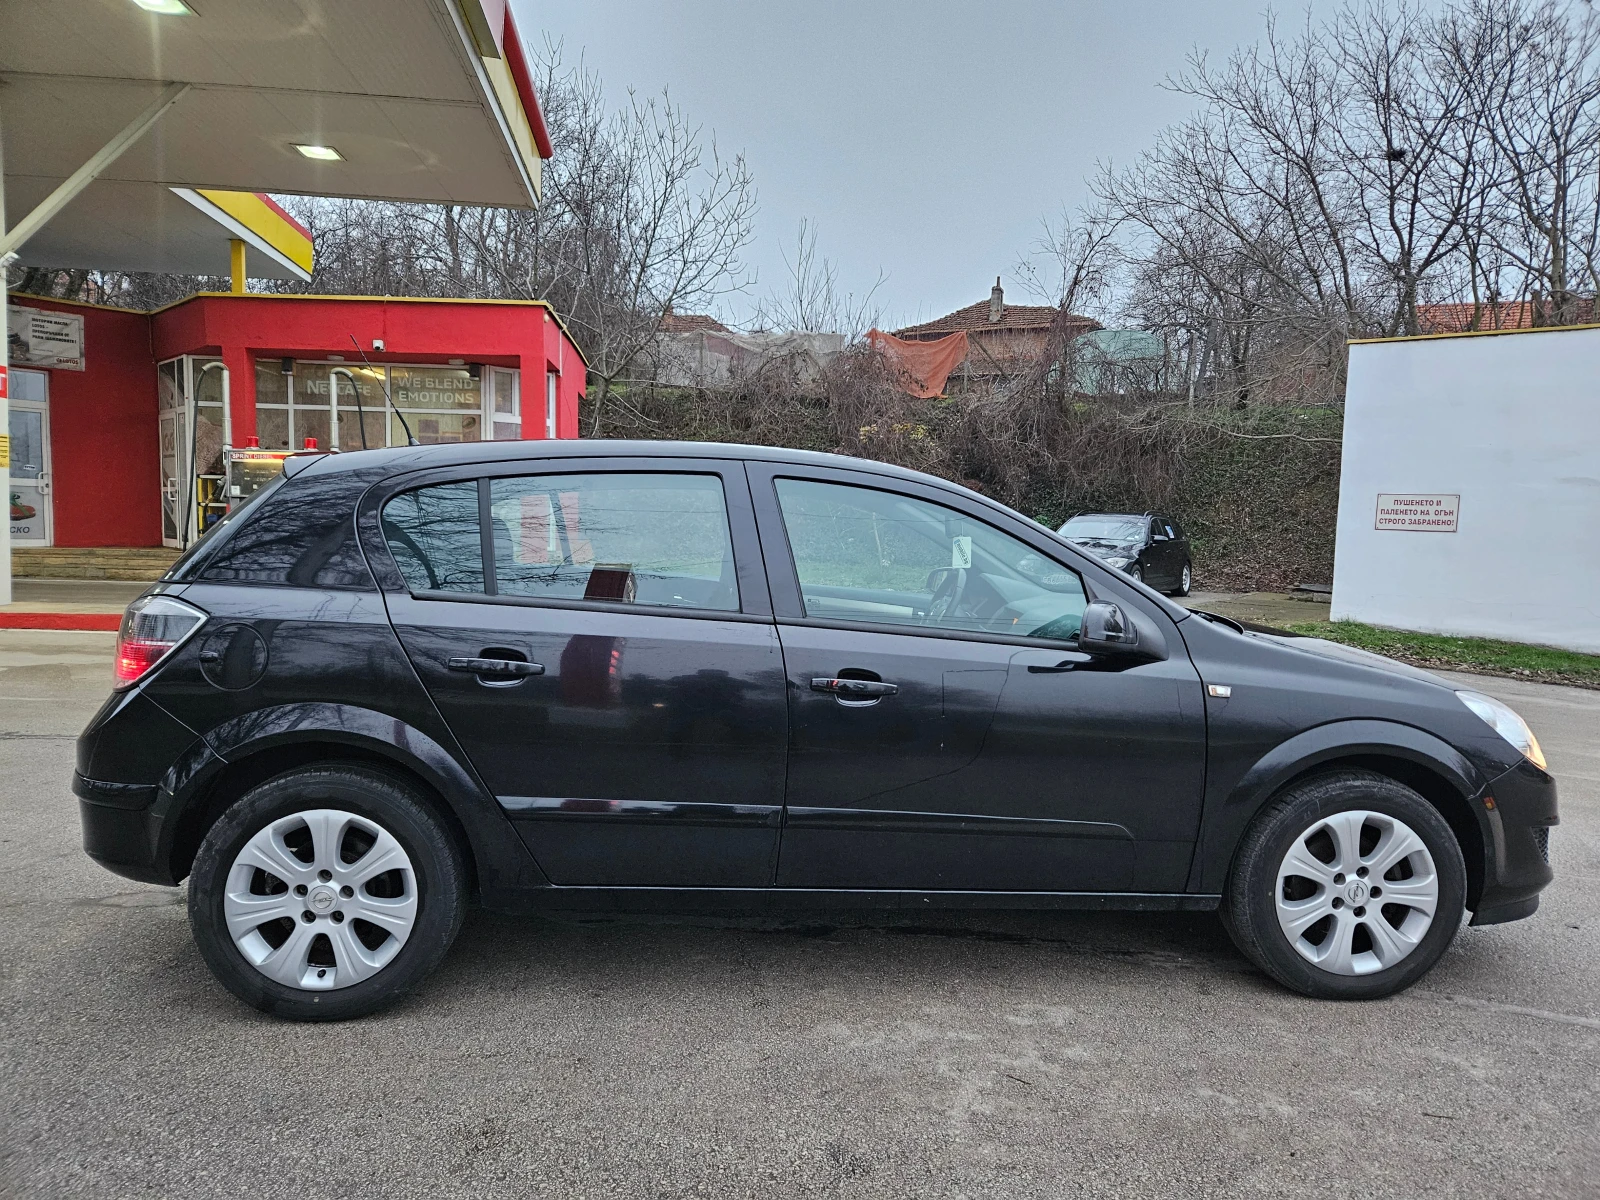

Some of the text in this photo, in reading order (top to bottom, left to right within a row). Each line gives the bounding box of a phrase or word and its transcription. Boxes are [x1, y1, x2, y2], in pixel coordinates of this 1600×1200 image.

[398, 377, 473, 389] WE BLEND
[398, 390, 474, 403] EMOTIONS
